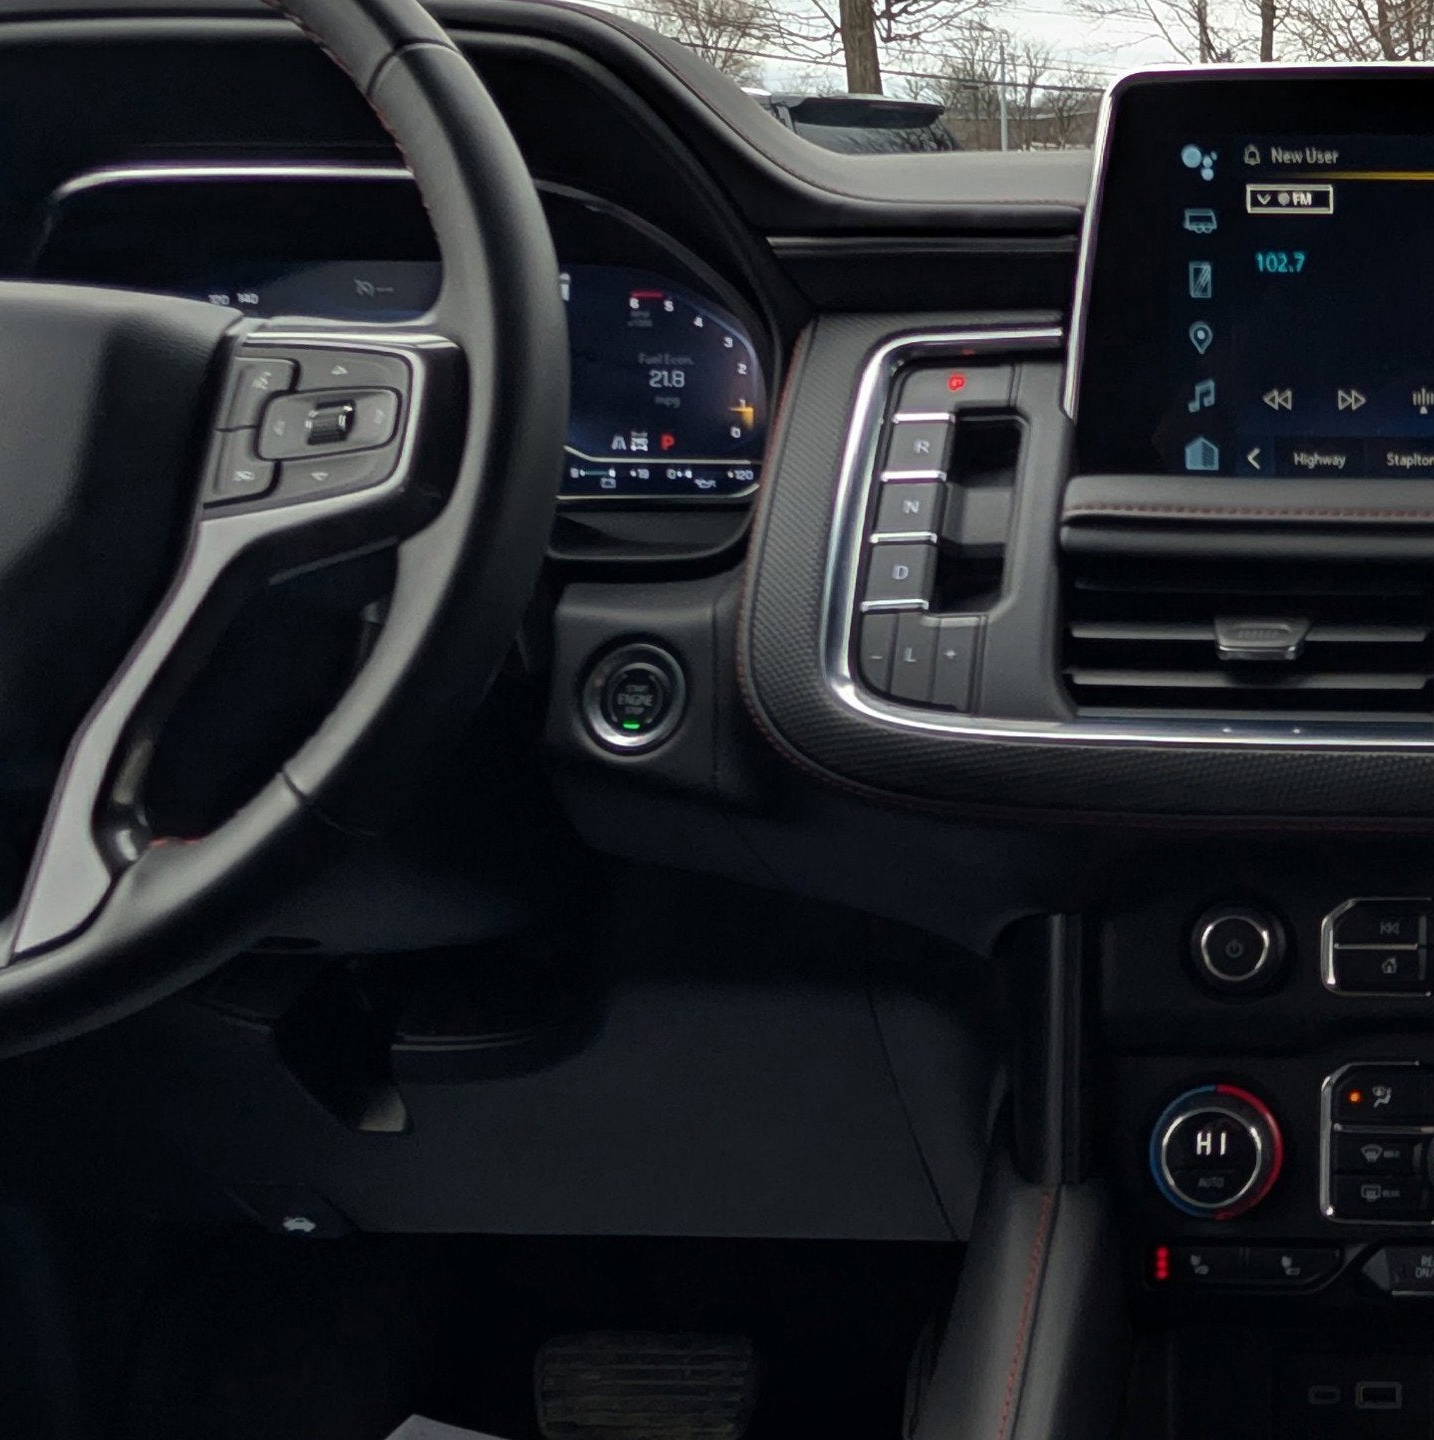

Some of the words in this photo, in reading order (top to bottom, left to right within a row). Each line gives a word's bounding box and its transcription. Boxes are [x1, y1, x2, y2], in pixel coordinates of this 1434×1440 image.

[1271, 146, 1304, 163] New
[1305, 147, 1339, 164] User
[1292, 191, 1313, 206] FM
[1255, 251, 1306, 273] 102.7
[663, 300, 675, 312] 5
[693, 316, 704, 328] 4
[723, 336, 734, 348] 3
[638, 352, 663, 365] Fuel
[737, 363, 748, 375] 2
[730, 426, 742, 438] 0
[659, 431, 675, 450] P
[914, 440, 932, 455] R
[1293, 451, 1346, 469] Highway
[903, 499, 920, 515] N
[893, 564, 911, 581] D
[1196, 1131, 1227, 1156] HI
